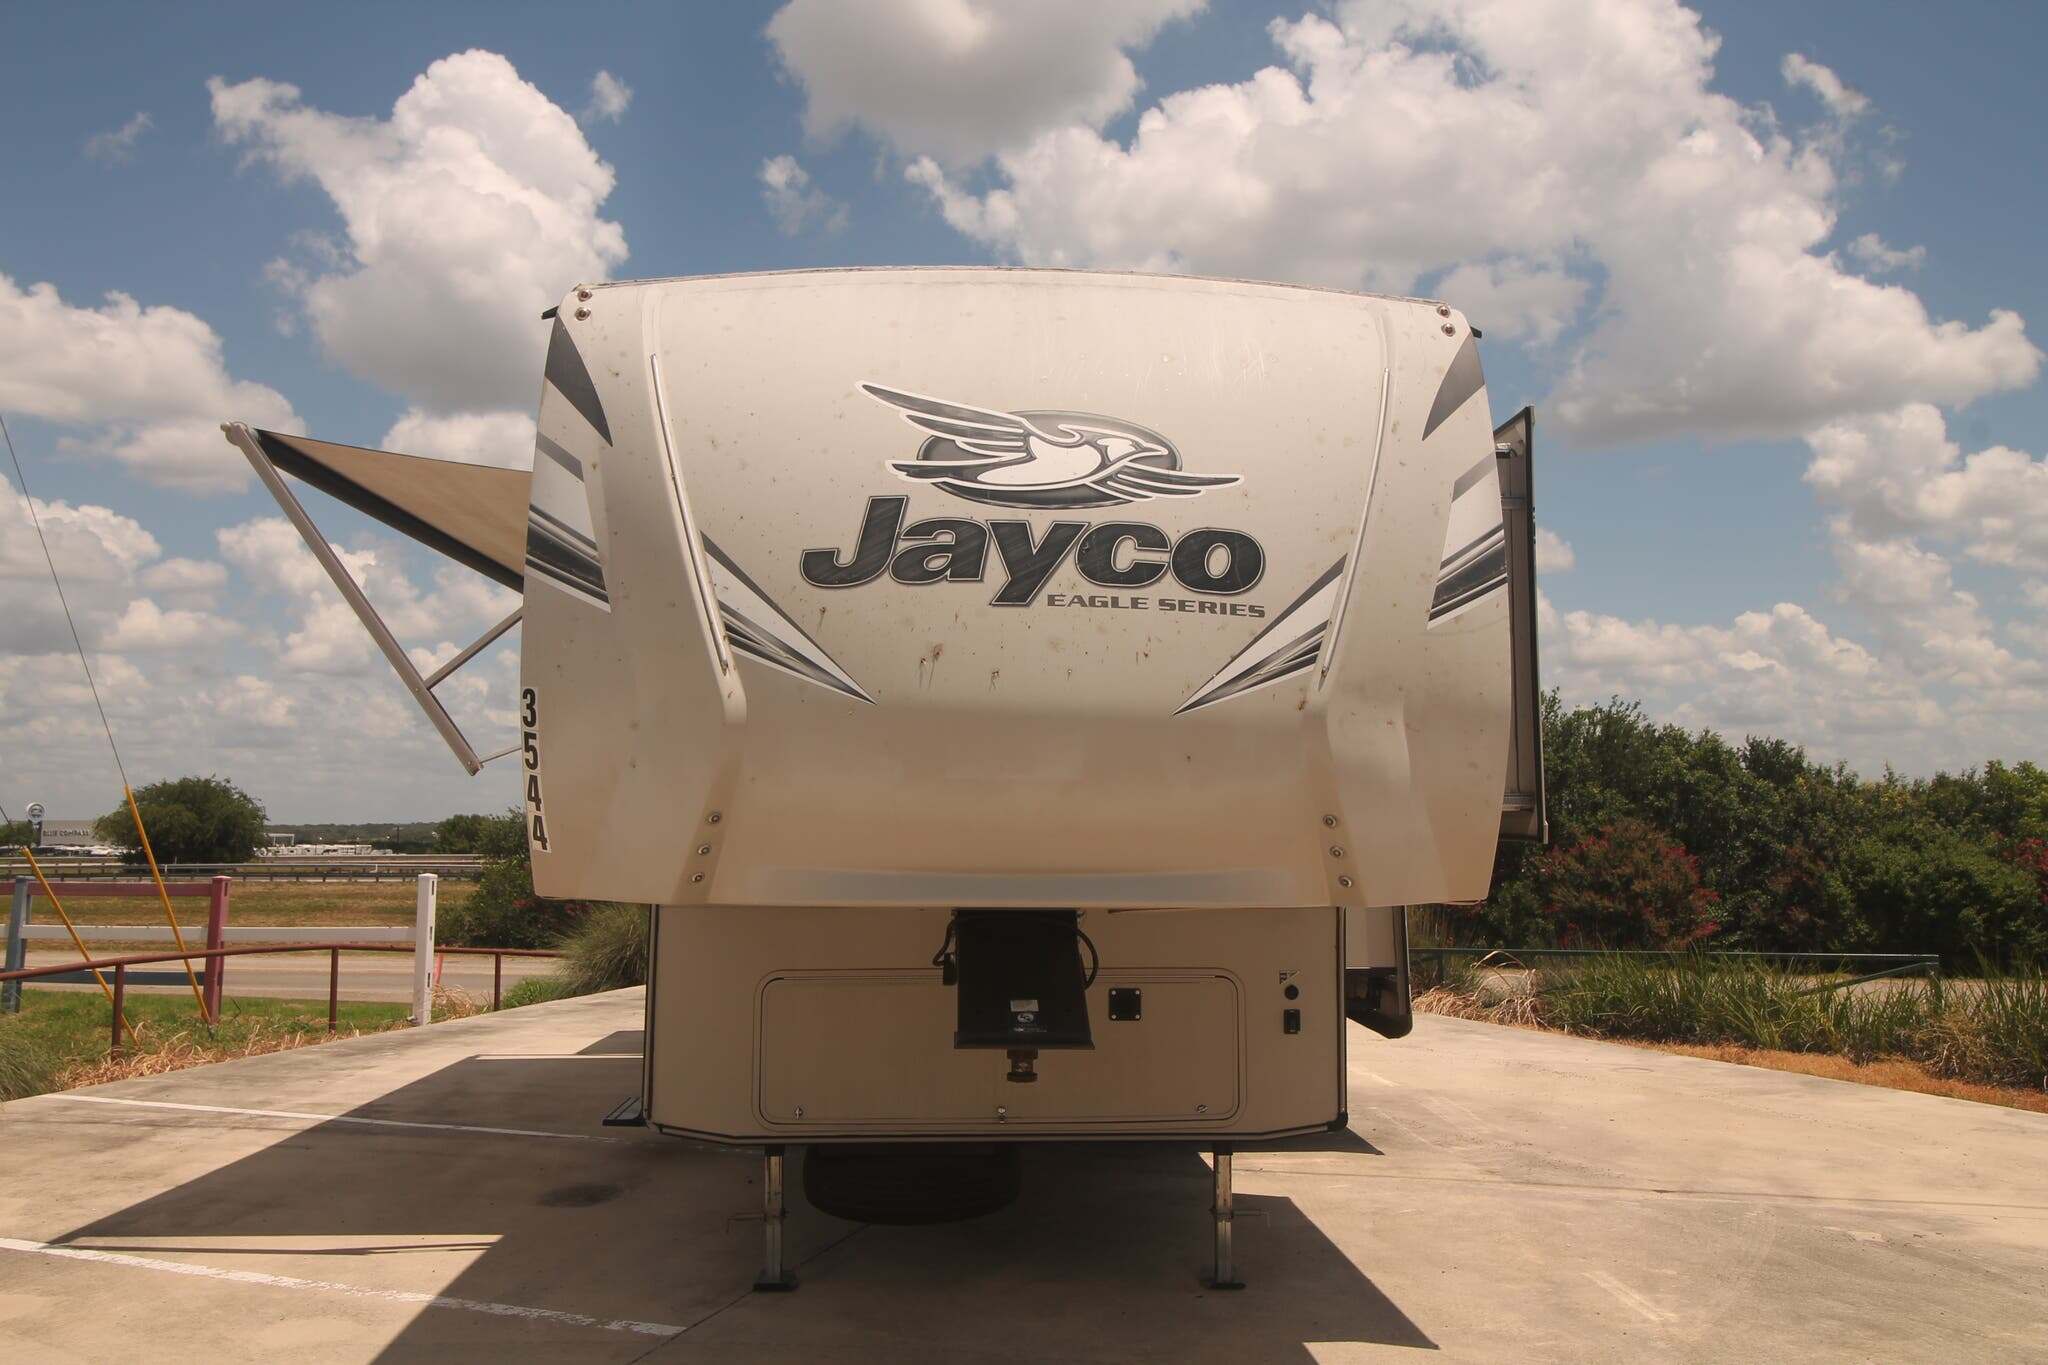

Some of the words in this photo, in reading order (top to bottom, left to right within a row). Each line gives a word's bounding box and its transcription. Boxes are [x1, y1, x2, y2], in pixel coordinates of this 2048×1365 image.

[800, 495, 1266, 606] Jayco
[1047, 594, 1149, 610] EAGLE
[1158, 599, 1265, 618] SERIES
[522, 688, 548, 851] 3544
